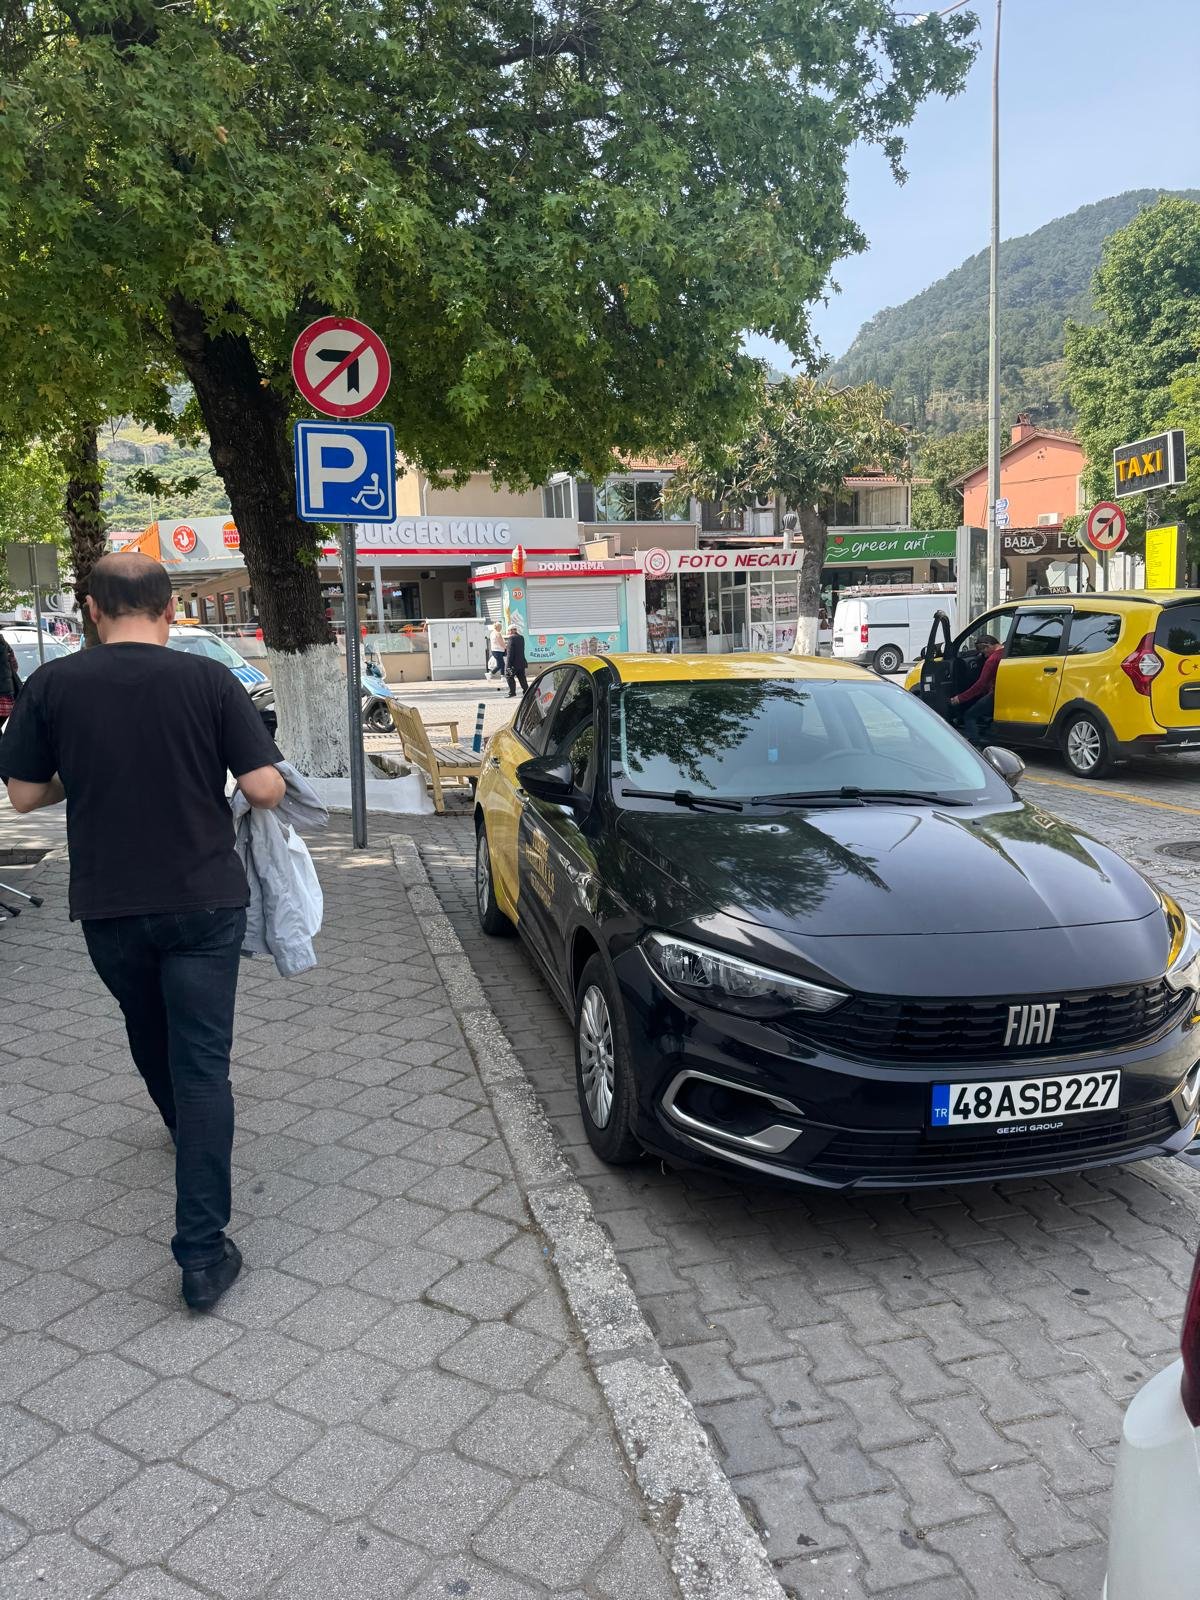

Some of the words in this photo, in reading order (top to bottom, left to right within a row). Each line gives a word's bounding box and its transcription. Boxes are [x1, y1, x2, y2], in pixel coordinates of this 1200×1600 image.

[306, 433, 368, 508] P
[1115, 449, 1163, 482] TAXI
[450, 521, 511, 545] KING
[1004, 536, 1036, 548] BABA
[851, 540, 898, 559] green
[904, 533, 935, 551] art
[538, 561, 605, 571] DONDURMA
[678, 555, 728, 568] FOTO
[735, 550, 799, 567] NECATİ
[1003, 1003, 1060, 1047] FIAT
[952, 1073, 1118, 1120] 48ASB227
[934, 1107, 948, 1118] TR
[1029, 1121, 1064, 1132] GROUP
